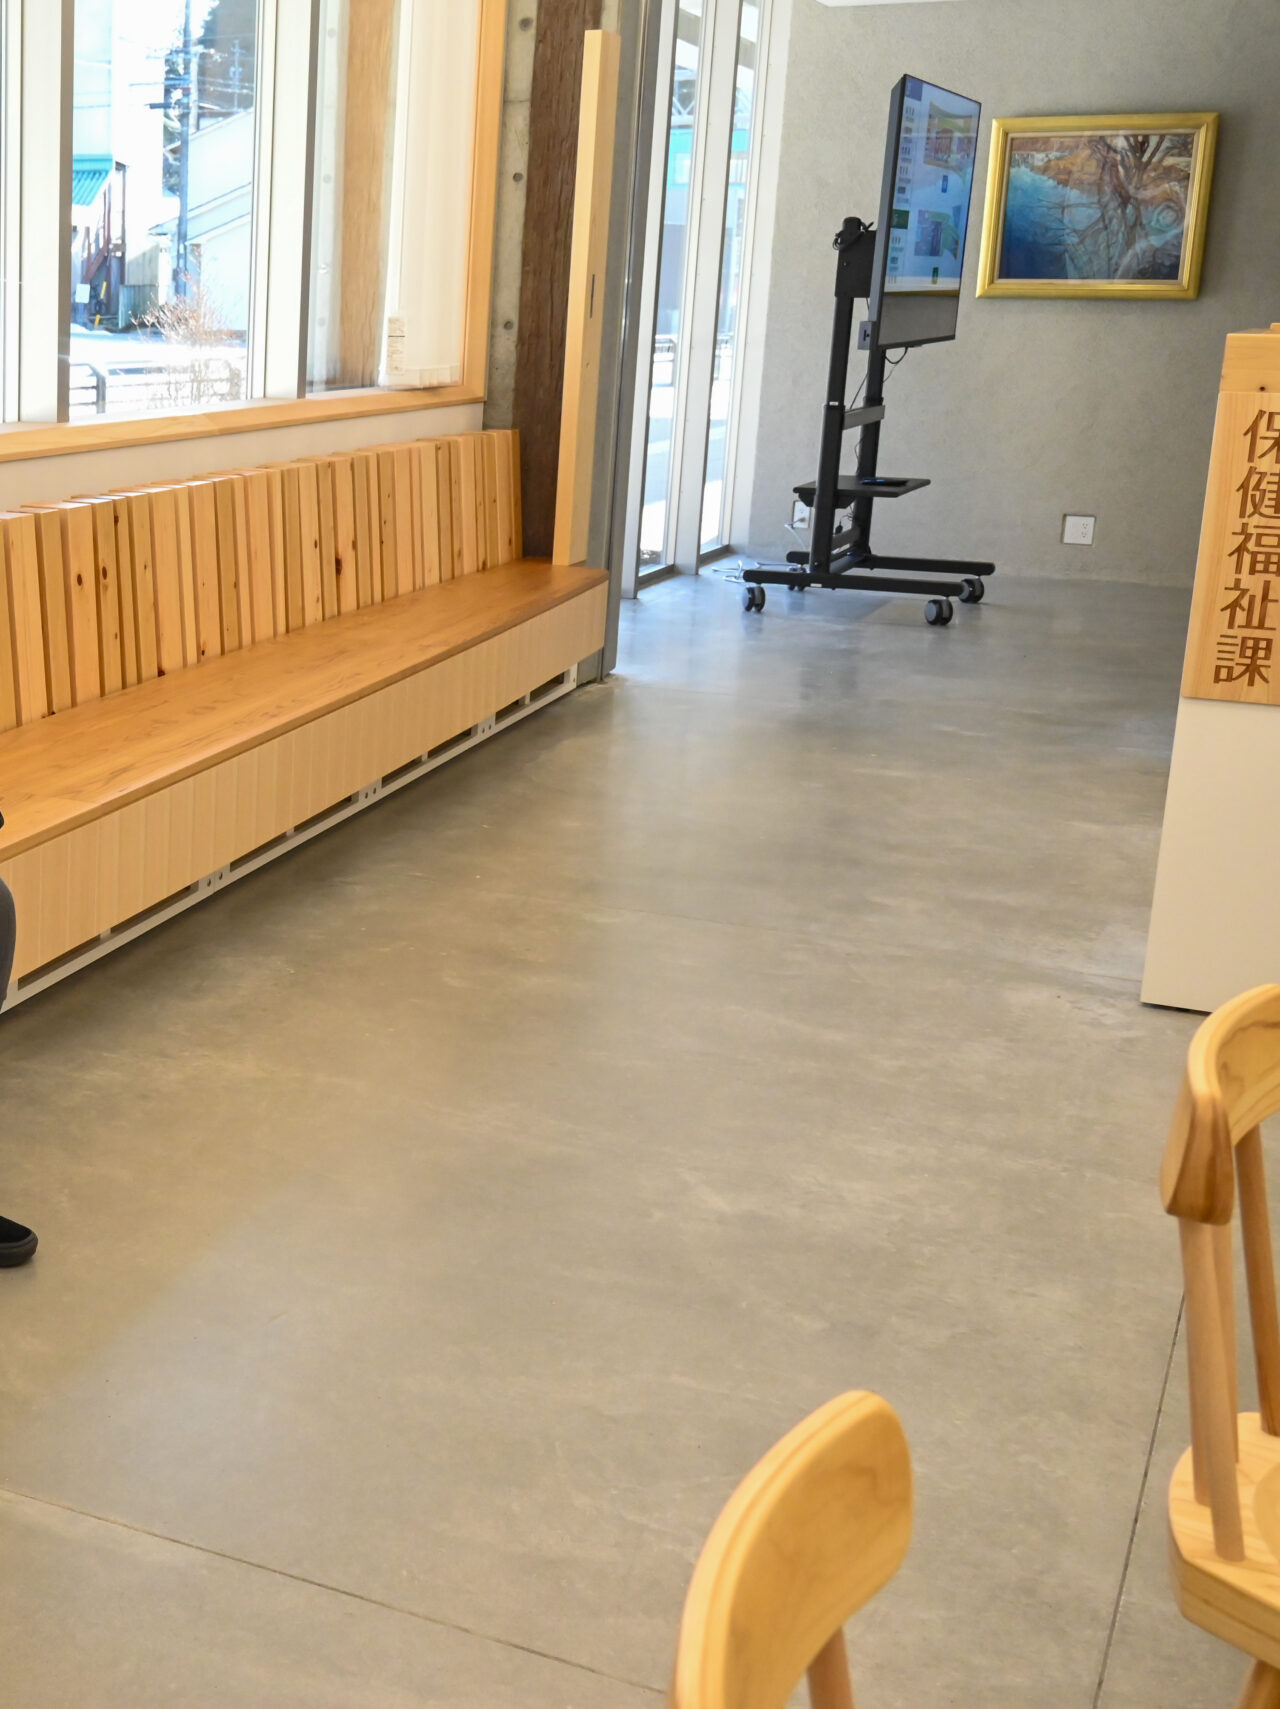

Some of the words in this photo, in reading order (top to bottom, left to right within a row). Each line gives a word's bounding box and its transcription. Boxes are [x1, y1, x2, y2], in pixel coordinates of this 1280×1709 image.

[1213, 408, 1280, 687] 保健福祉課
